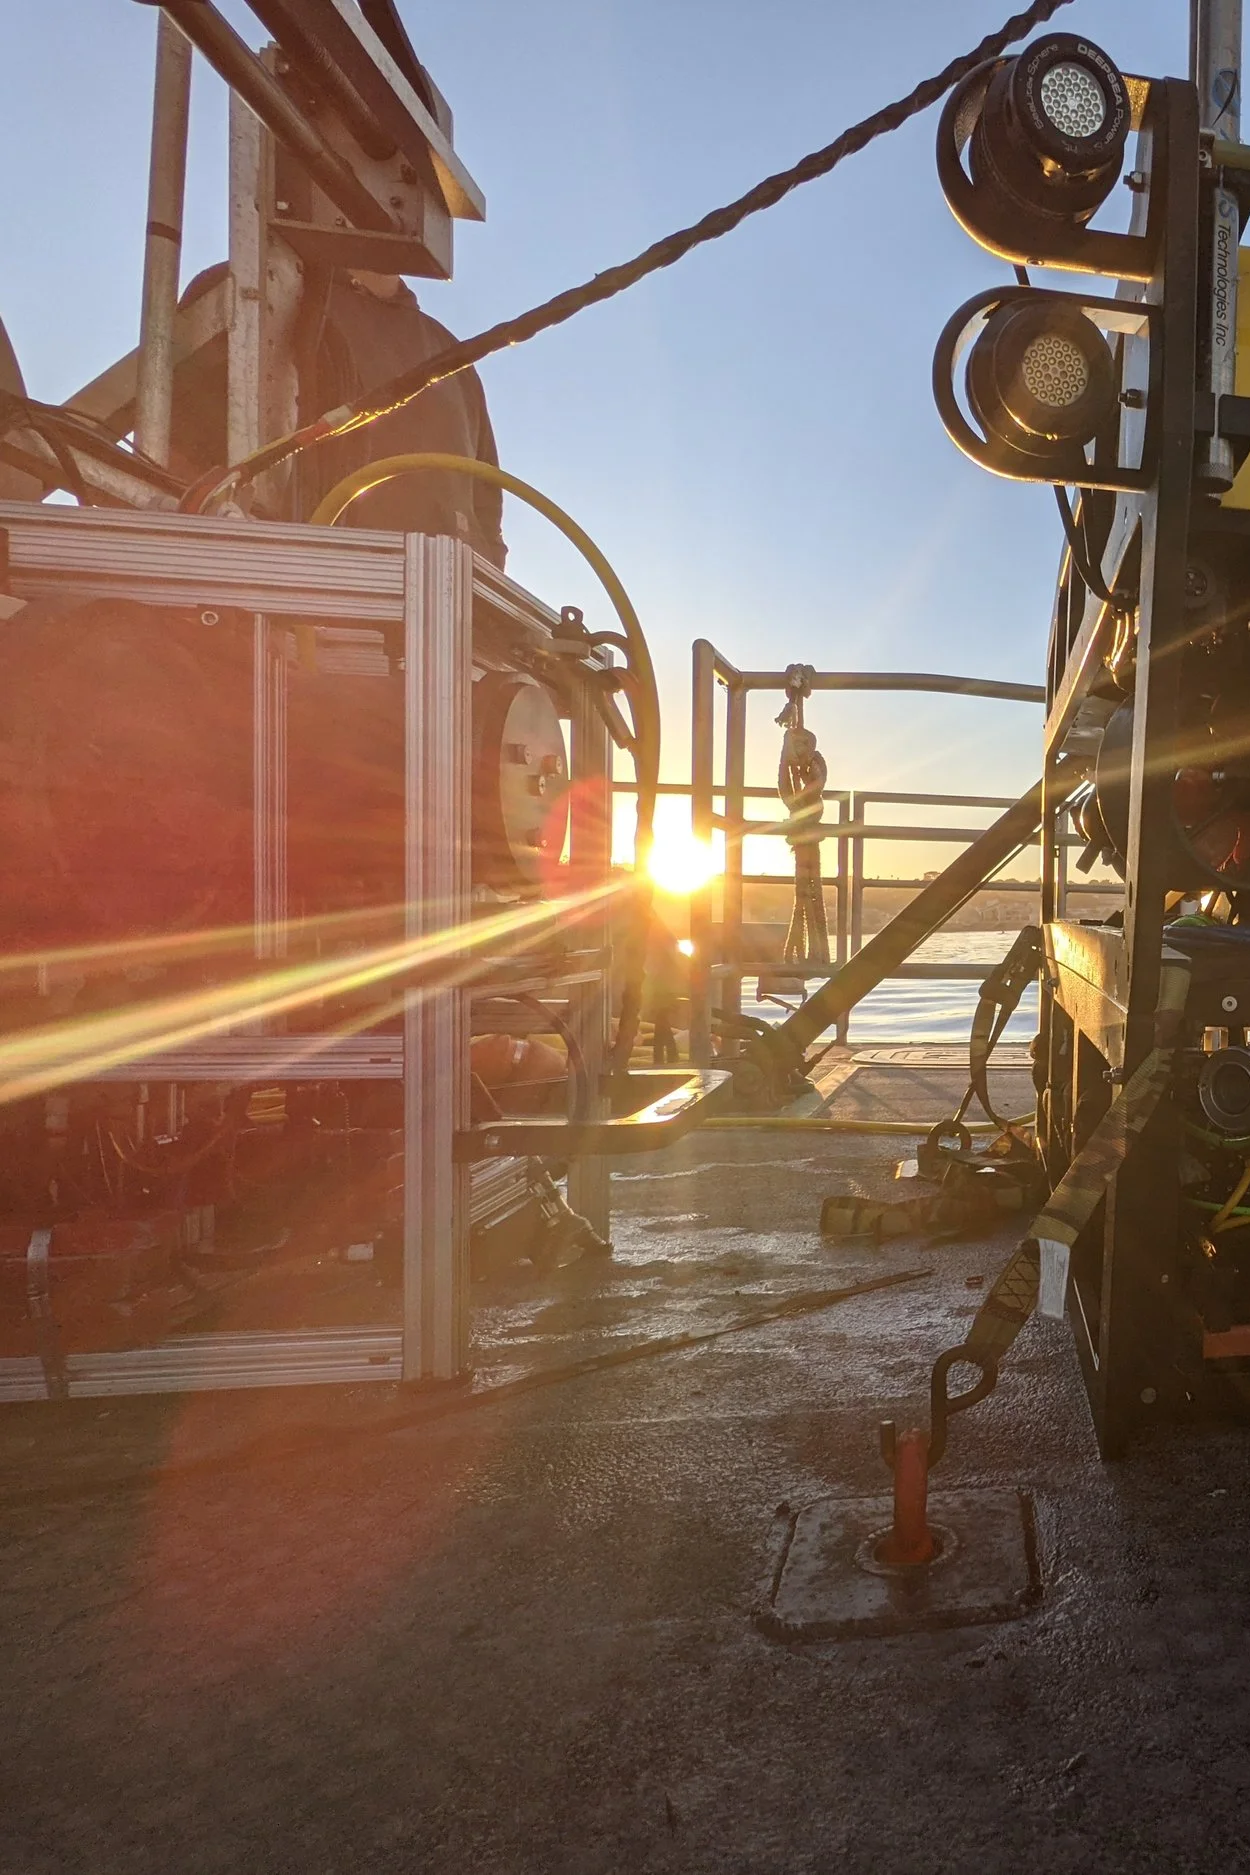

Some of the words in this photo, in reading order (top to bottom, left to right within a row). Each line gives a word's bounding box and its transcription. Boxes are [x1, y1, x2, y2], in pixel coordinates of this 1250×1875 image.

[1027, 43, 1058, 76] Sphere
[1077, 43, 1124, 106] DEEPSEA
[1104, 108, 1124, 145] Power
[1214, 224, 1231, 320] Technologies
[1215, 322, 1229, 347] Inc
